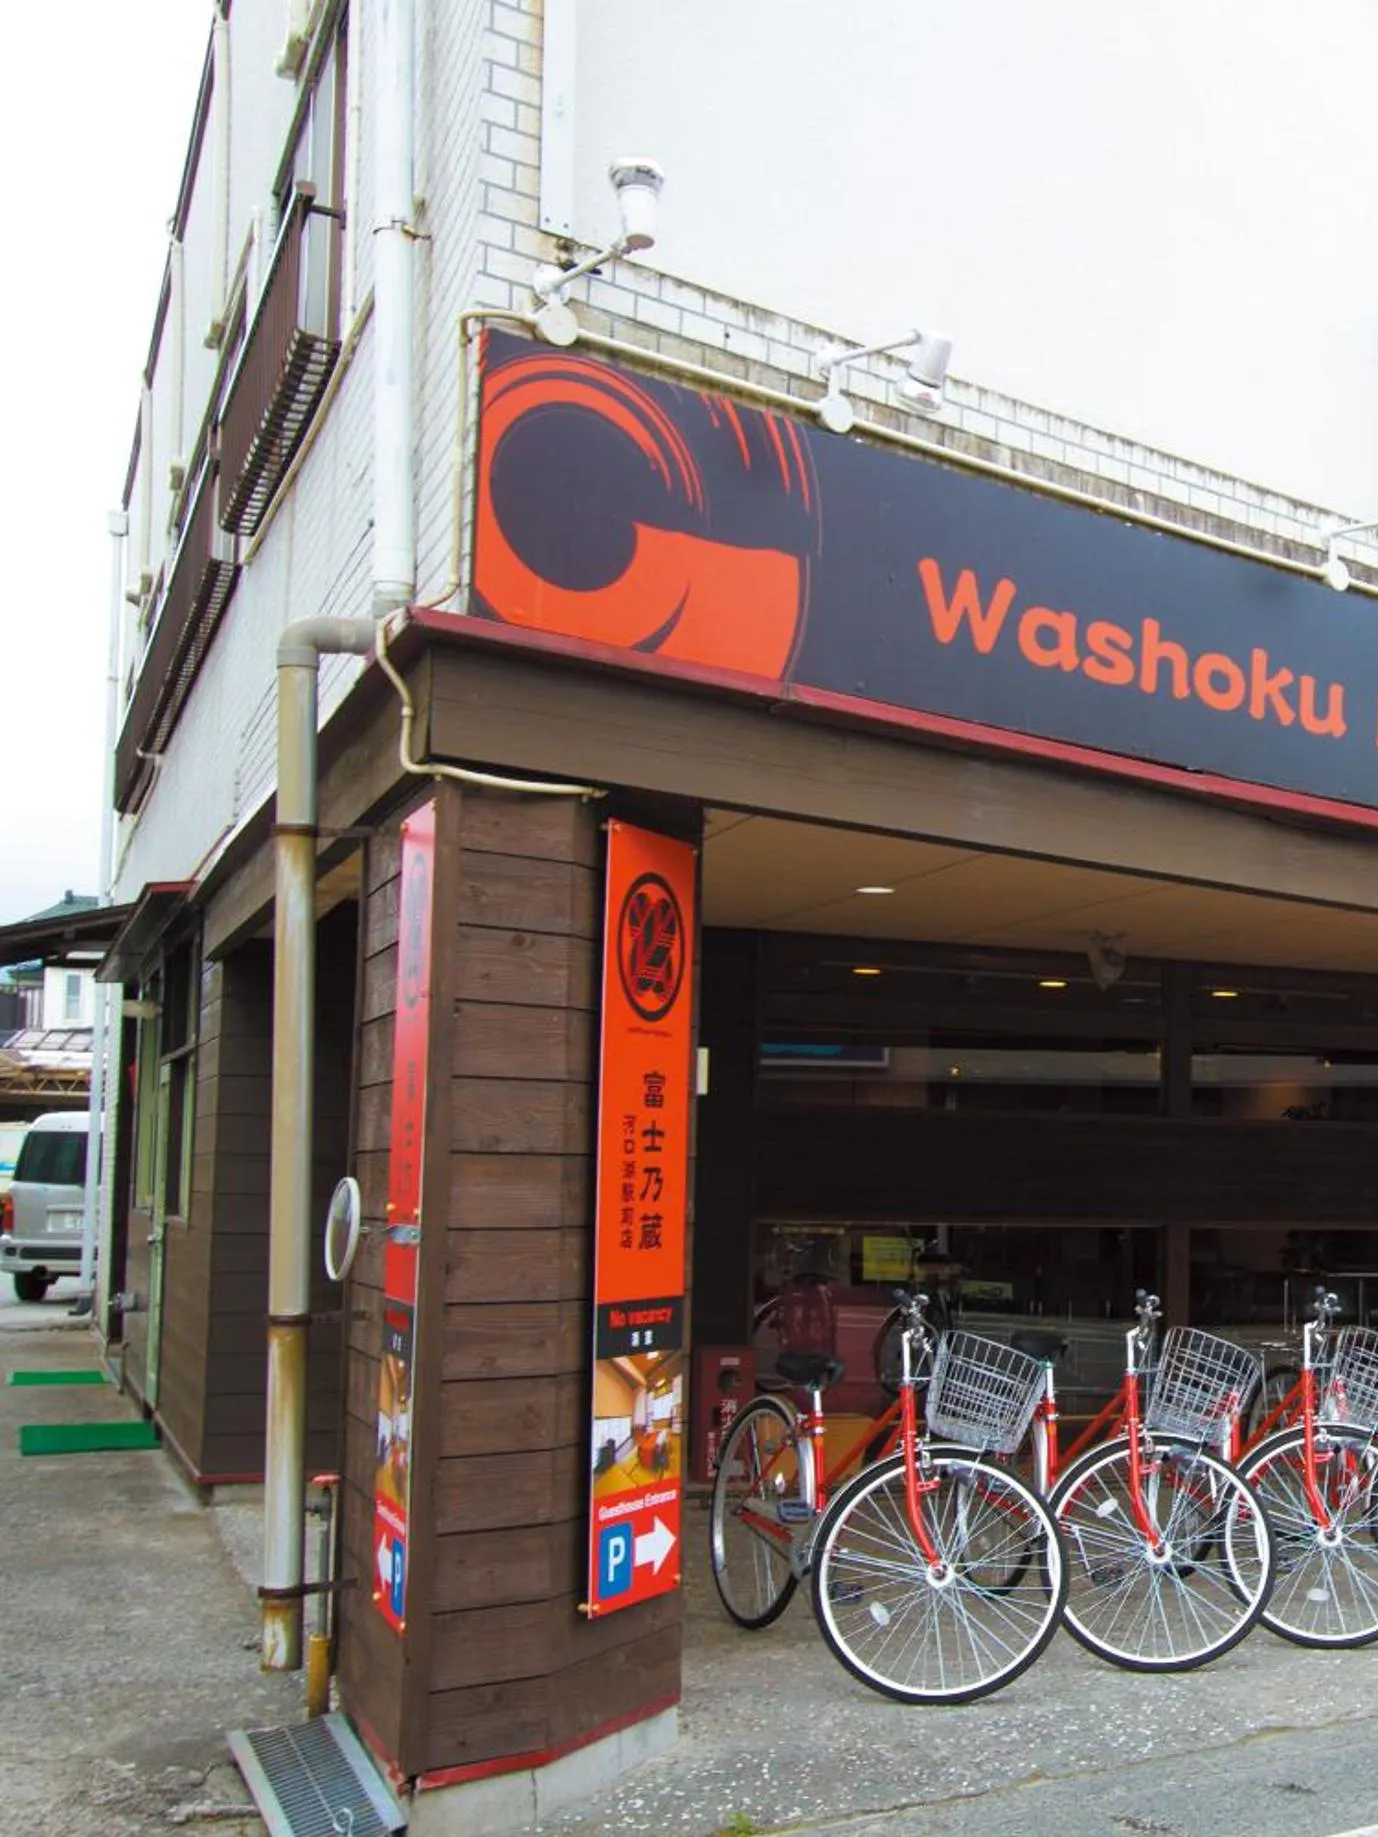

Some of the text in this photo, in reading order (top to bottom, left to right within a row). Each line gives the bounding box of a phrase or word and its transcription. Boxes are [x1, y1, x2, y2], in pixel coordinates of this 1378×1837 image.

[917, 557, 1347, 738] Washoku
[639, 1070, 666, 1250] 富士乃蔵
[607, 1536, 625, 1583] P
